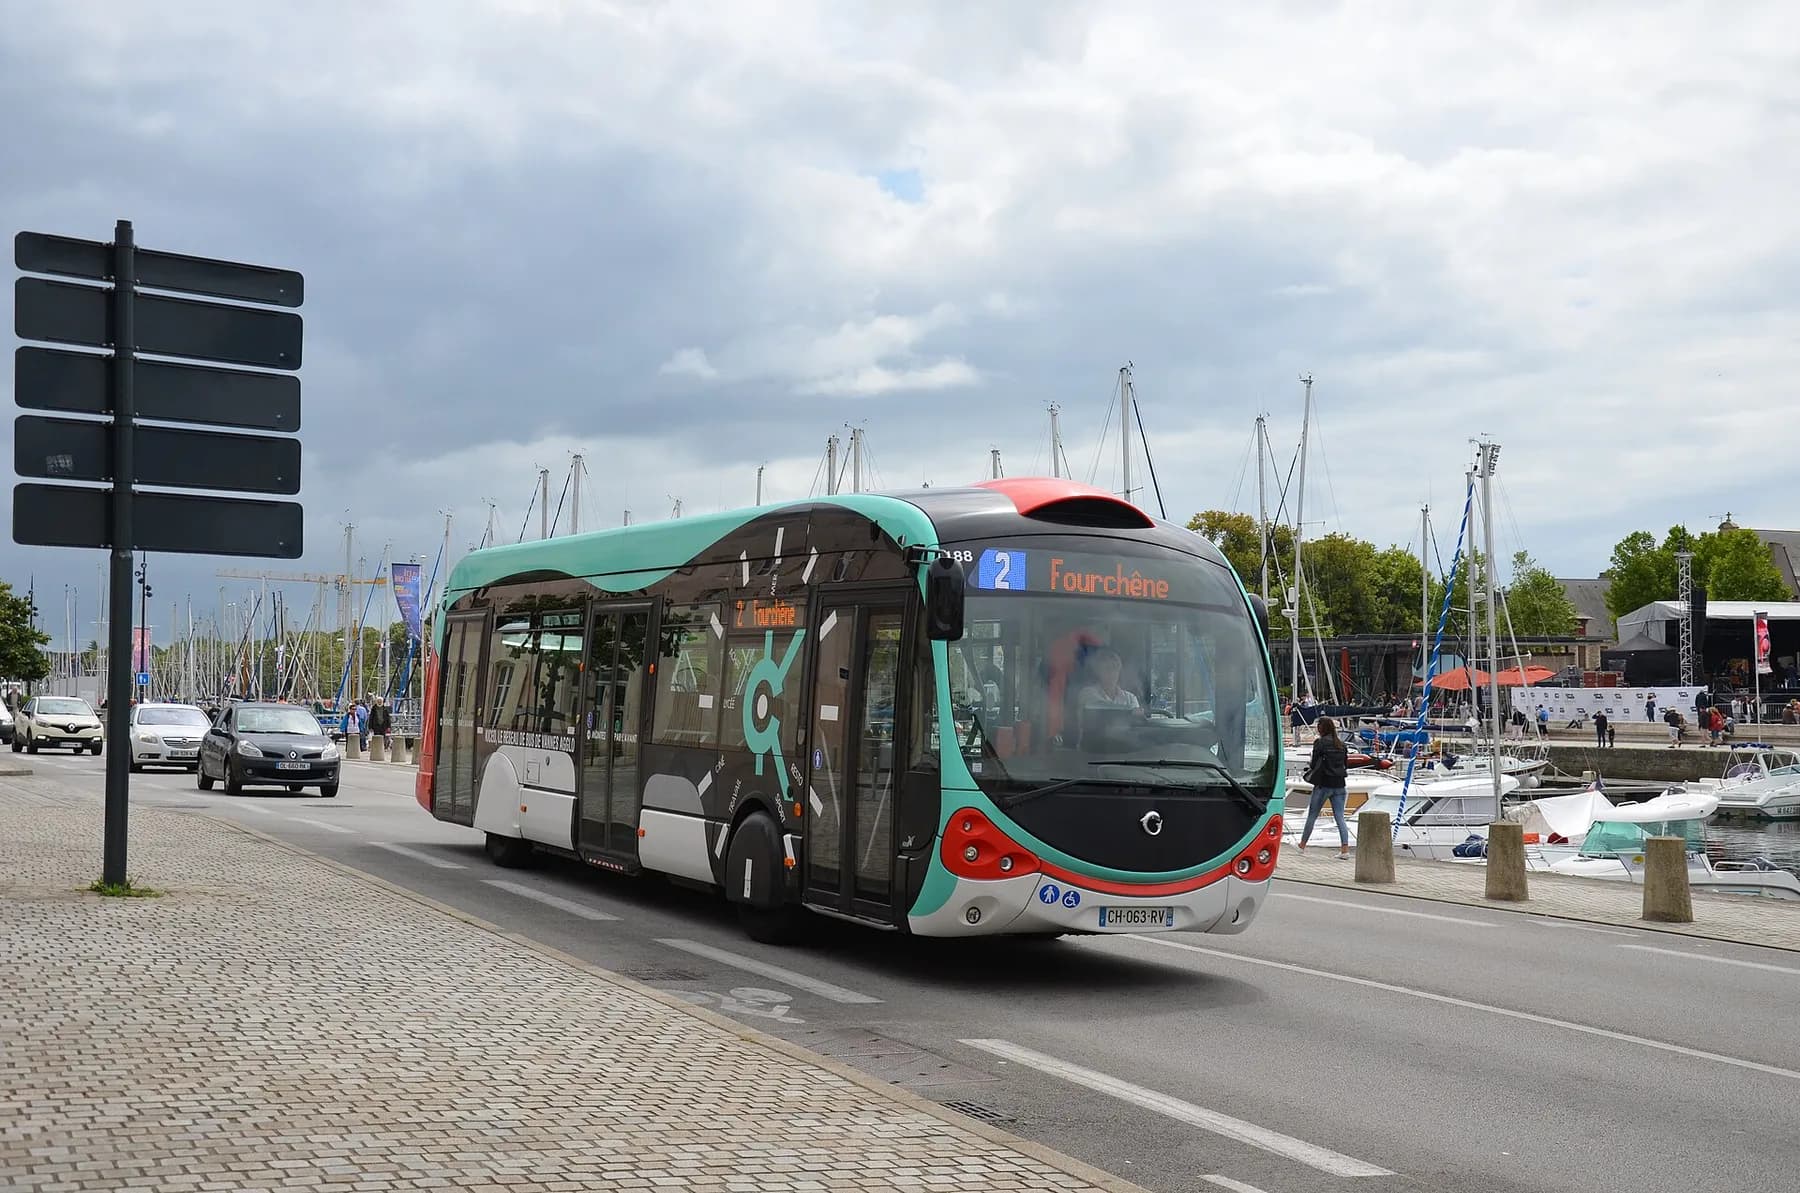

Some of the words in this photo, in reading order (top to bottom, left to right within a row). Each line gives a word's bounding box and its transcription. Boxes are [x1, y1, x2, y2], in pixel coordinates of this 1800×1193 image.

[770, 573, 778, 596] MER
[994, 551, 1011, 589] 2
[1050, 558, 1169, 598] Fourchêne
[736, 599, 745, 627] 2
[752, 598, 796, 626] Fourchêne
[519, 731, 526, 746] DE
[526, 732, 534, 747] BUS
[535, 733, 541, 748] DE
[541, 734, 559, 751] VANNES
[559, 735, 576, 753] AGGLO
[790, 762, 804, 787] RESTO
[728, 778, 742, 814] TRAVAIL
[775, 793, 786, 823] SPORT
[1107, 910, 1165, 924] CH-063-RV
